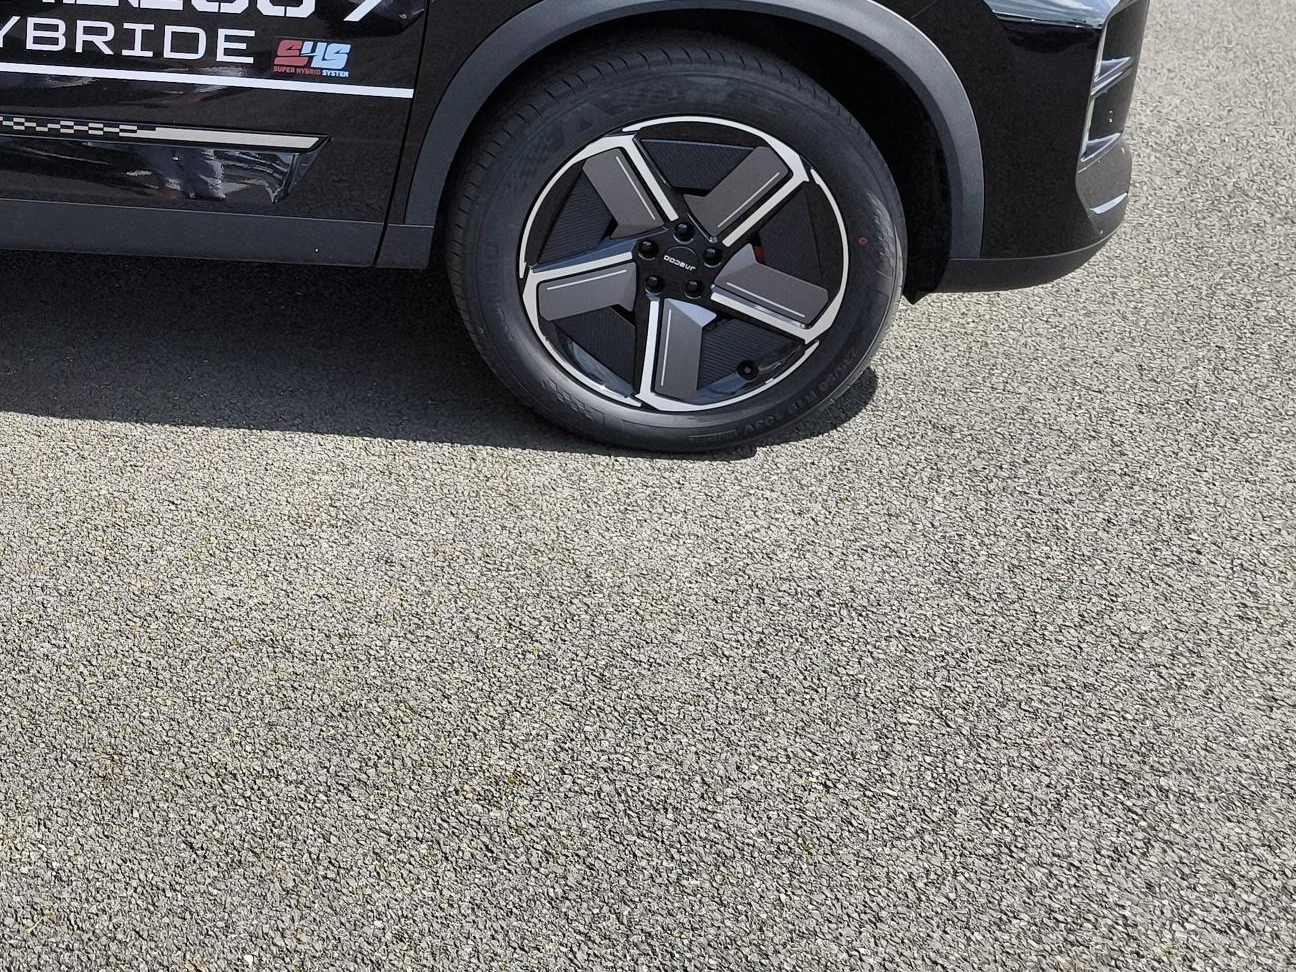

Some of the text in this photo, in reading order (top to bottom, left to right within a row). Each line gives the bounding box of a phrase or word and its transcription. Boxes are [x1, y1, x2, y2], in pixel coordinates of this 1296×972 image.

[273, 66, 349, 78] SUPER HYBRID SYSTEM
